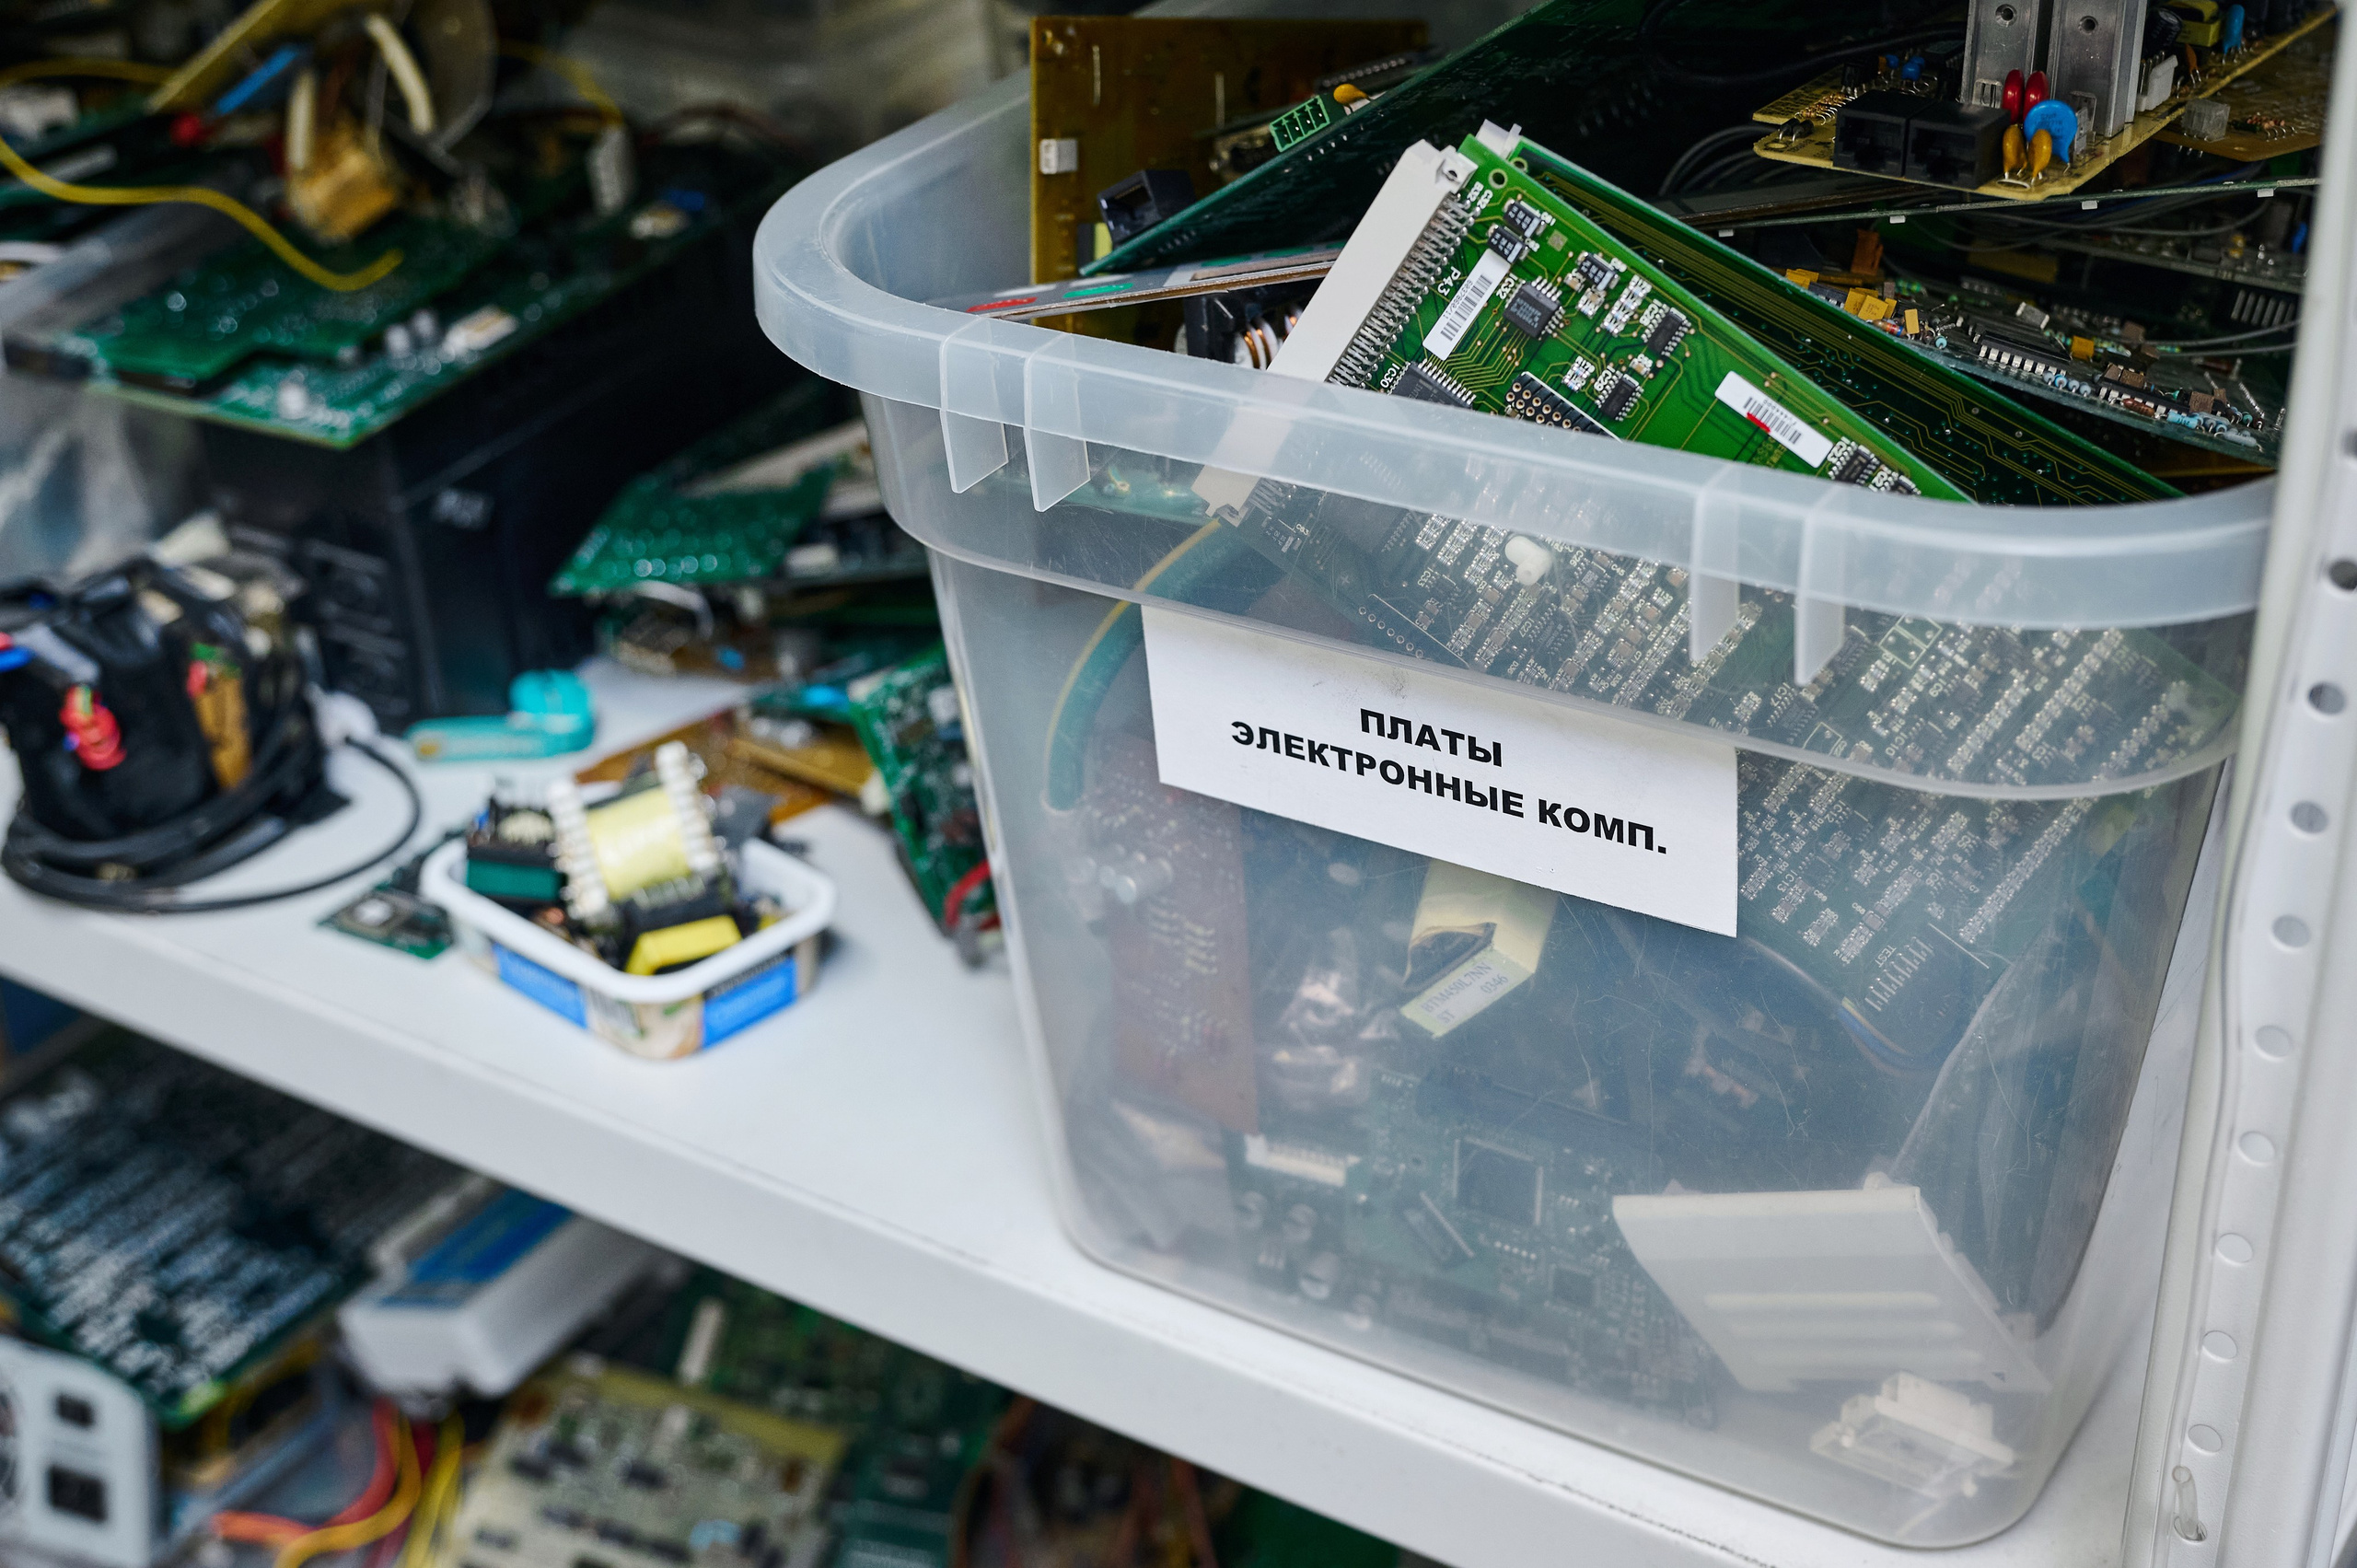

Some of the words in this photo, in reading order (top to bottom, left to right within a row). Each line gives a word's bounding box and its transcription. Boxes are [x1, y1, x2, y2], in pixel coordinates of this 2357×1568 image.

[1437, 266, 1461, 296] P43
[1495, 273, 1518, 300] IC32
[1380, 363, 1400, 389] IC30
[1594, 365, 1616, 391] IC29
[1569, 546, 1586, 567] IC26
[1418, 567, 1434, 587] IC33
[1611, 564, 1624, 575] C45
[1655, 587, 1673, 601] R132
[1519, 617, 1535, 637] IC27
[1771, 682, 1794, 707] IC17
[1360, 707, 1503, 768] ПЛАТЫ
[1886, 733, 1909, 757] IC10
[1231, 721, 1524, 819] ЭЛЕКТРОННЫЕ
[1538, 798, 1667, 854] КОМП.
[1825, 799, 1846, 823] IC12
[1771, 831, 1784, 842] R77
[1793, 839, 1805, 853] D20
[1957, 830, 1976, 849] IC5
[1777, 861, 1788, 874] D21
[1907, 865, 1922, 877] C10
[1925, 868, 1944, 887] IC6
[1777, 870, 1799, 893] IC13
[1968, 885, 1979, 894] C7
[1875, 945, 1898, 968] TEST
[1480, 974, 1509, 994] 0346
